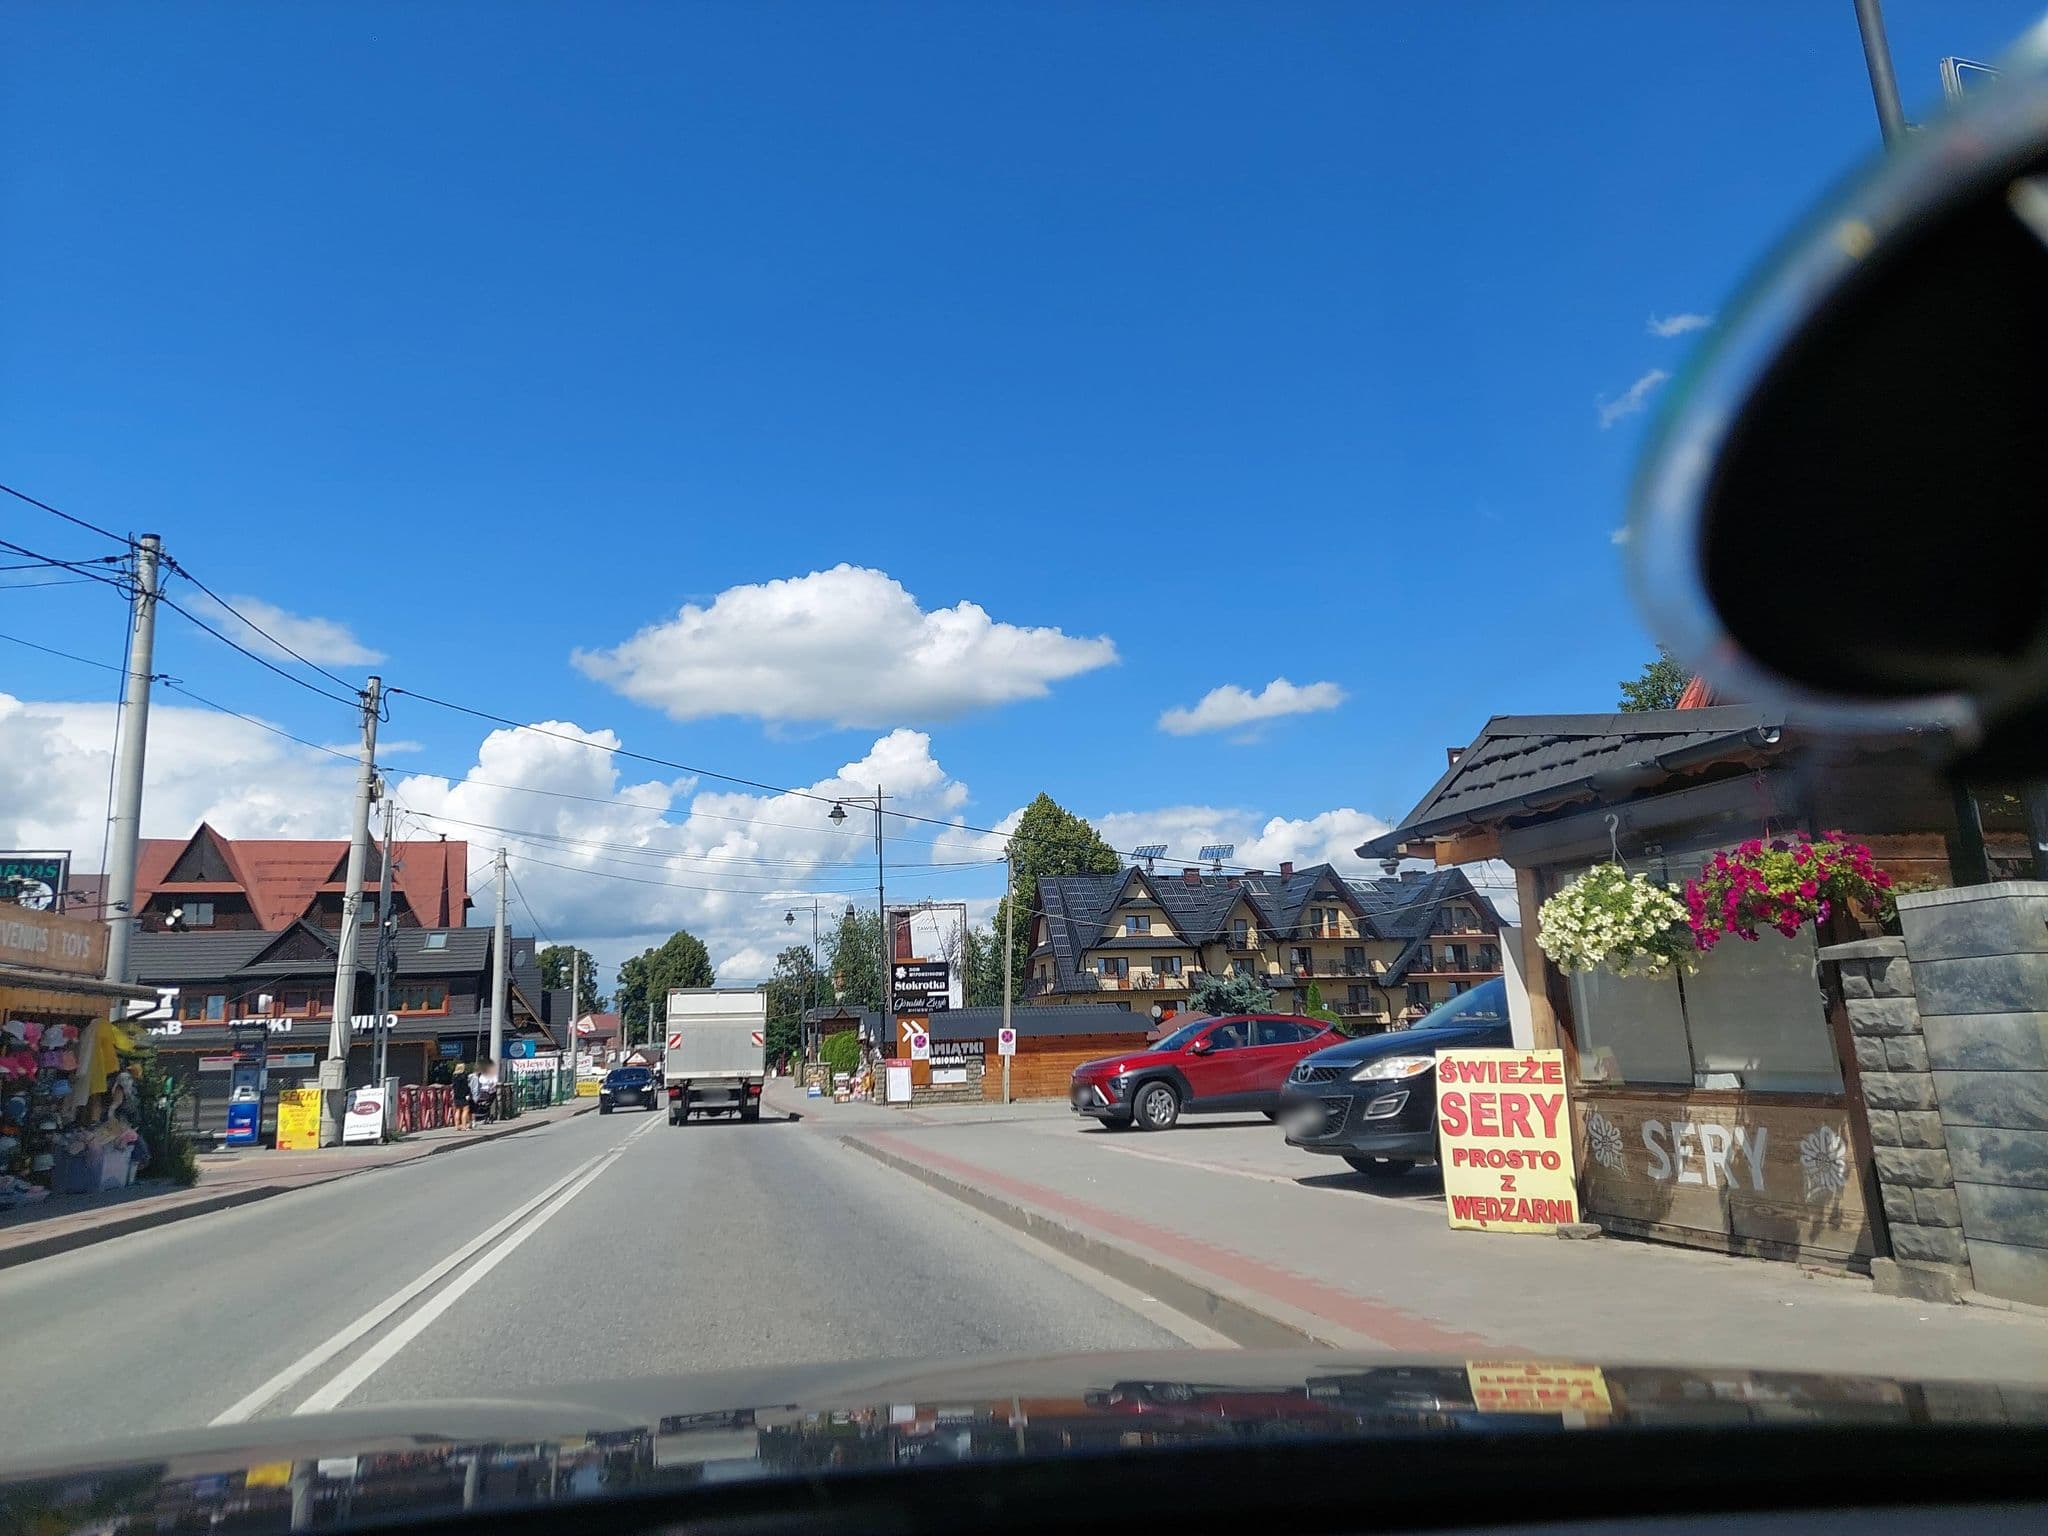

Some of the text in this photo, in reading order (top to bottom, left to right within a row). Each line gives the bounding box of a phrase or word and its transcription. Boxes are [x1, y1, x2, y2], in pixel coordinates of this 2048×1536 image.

[62, 931, 90, 959] TOYS
[895, 980, 945, 991] Stokrotka
[1439, 1056, 1563, 1085] ŚWIEŻE
[281, 1090, 319, 1101] SERKI
[1440, 1092, 1564, 1139] SERY
[1452, 1148, 1561, 1170] PROSTO
[1641, 1118, 1768, 1191] SERY
[1500, 1174, 1517, 1192] Z
[1451, 1195, 1574, 1227] WĘDZARNI
